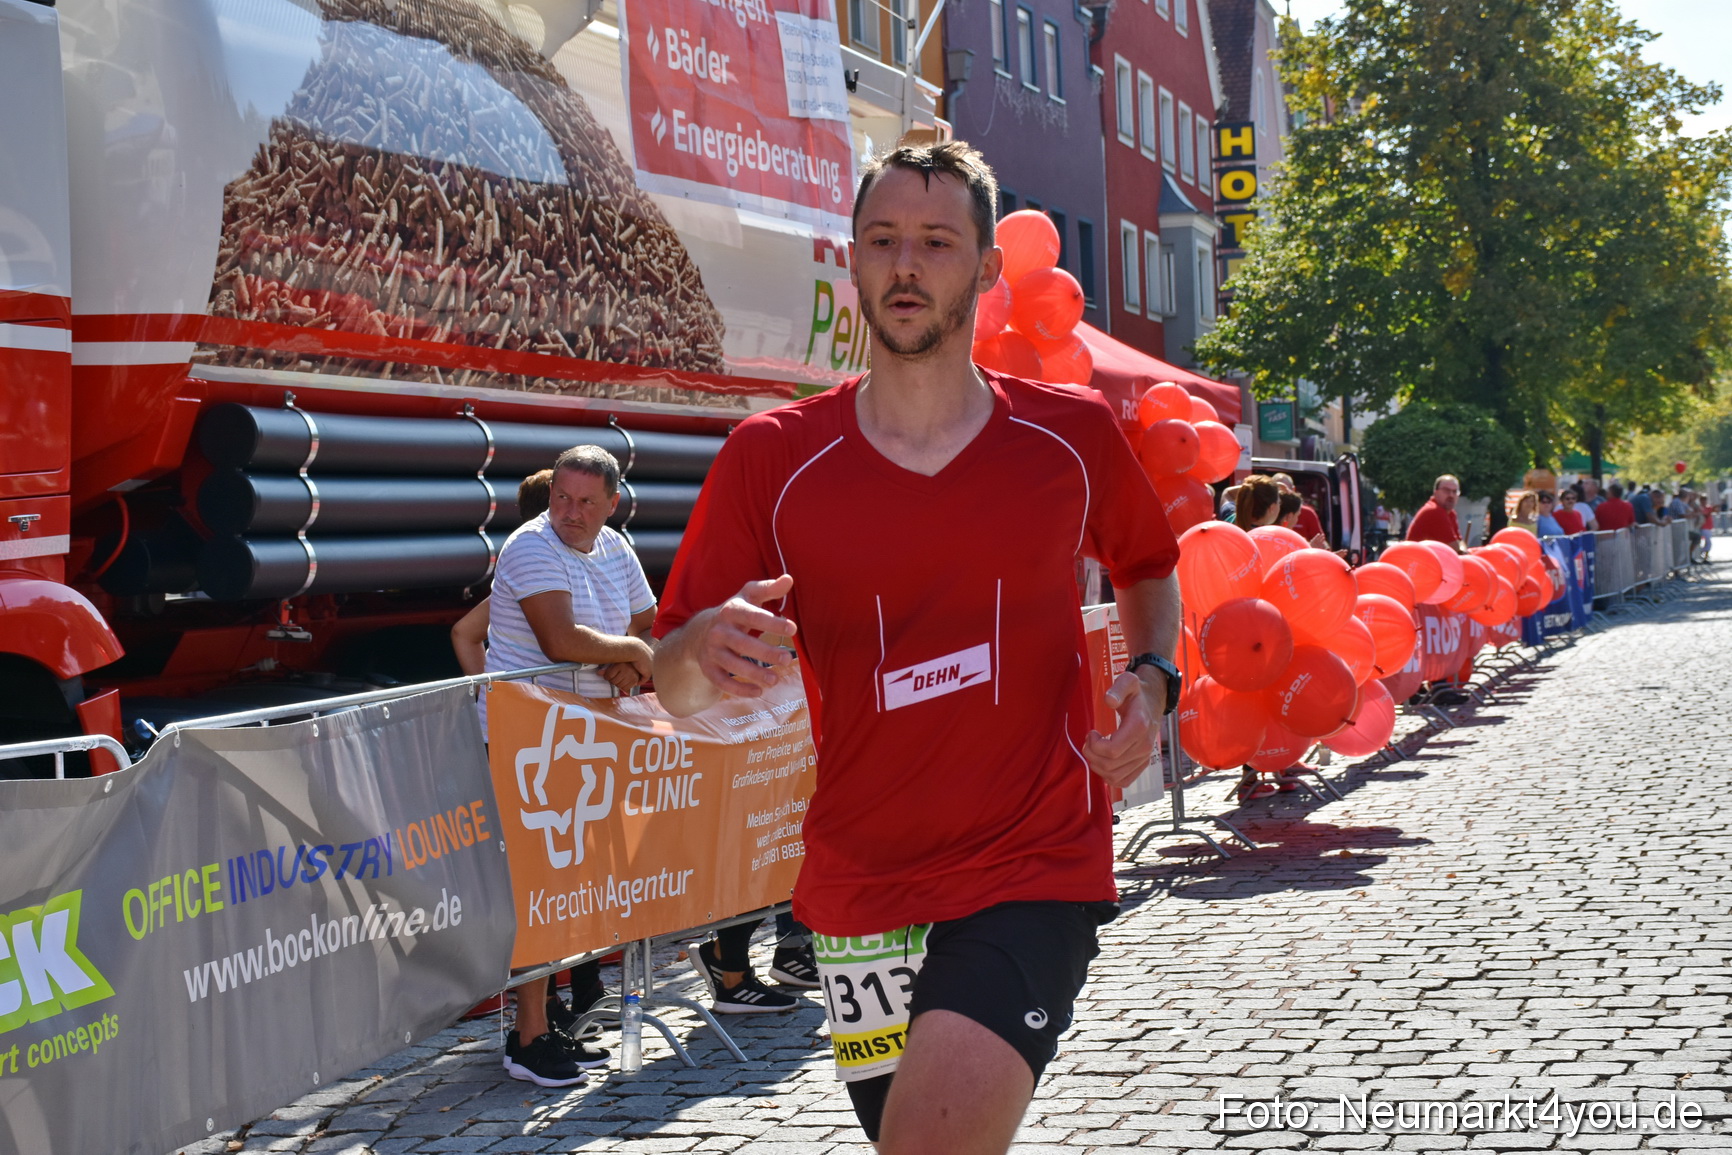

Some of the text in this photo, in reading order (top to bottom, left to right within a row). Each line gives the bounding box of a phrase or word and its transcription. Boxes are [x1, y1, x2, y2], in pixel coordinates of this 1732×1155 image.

[665, 28, 730, 85] Bäder
[672, 109, 841, 204] Energieberatung
[804, 279, 870, 372] Pell
[913, 663, 961, 692] DEHN
[629, 734, 693, 775] CODE
[732, 769, 775, 788] Grafikdesign
[624, 773, 702, 816] CLINIC
[746, 809, 773, 829] Melden
[791, 797, 806, 813] bei
[122, 800, 490, 940] OFFICE INDUSTRY LOUNGE
[528, 868, 694, 927] KreativAgentur
[183, 887, 463, 1003] www.bockonline.de
[27, 1012, 119, 1068] concepts
[834, 1029, 908, 1062] CHRIST
